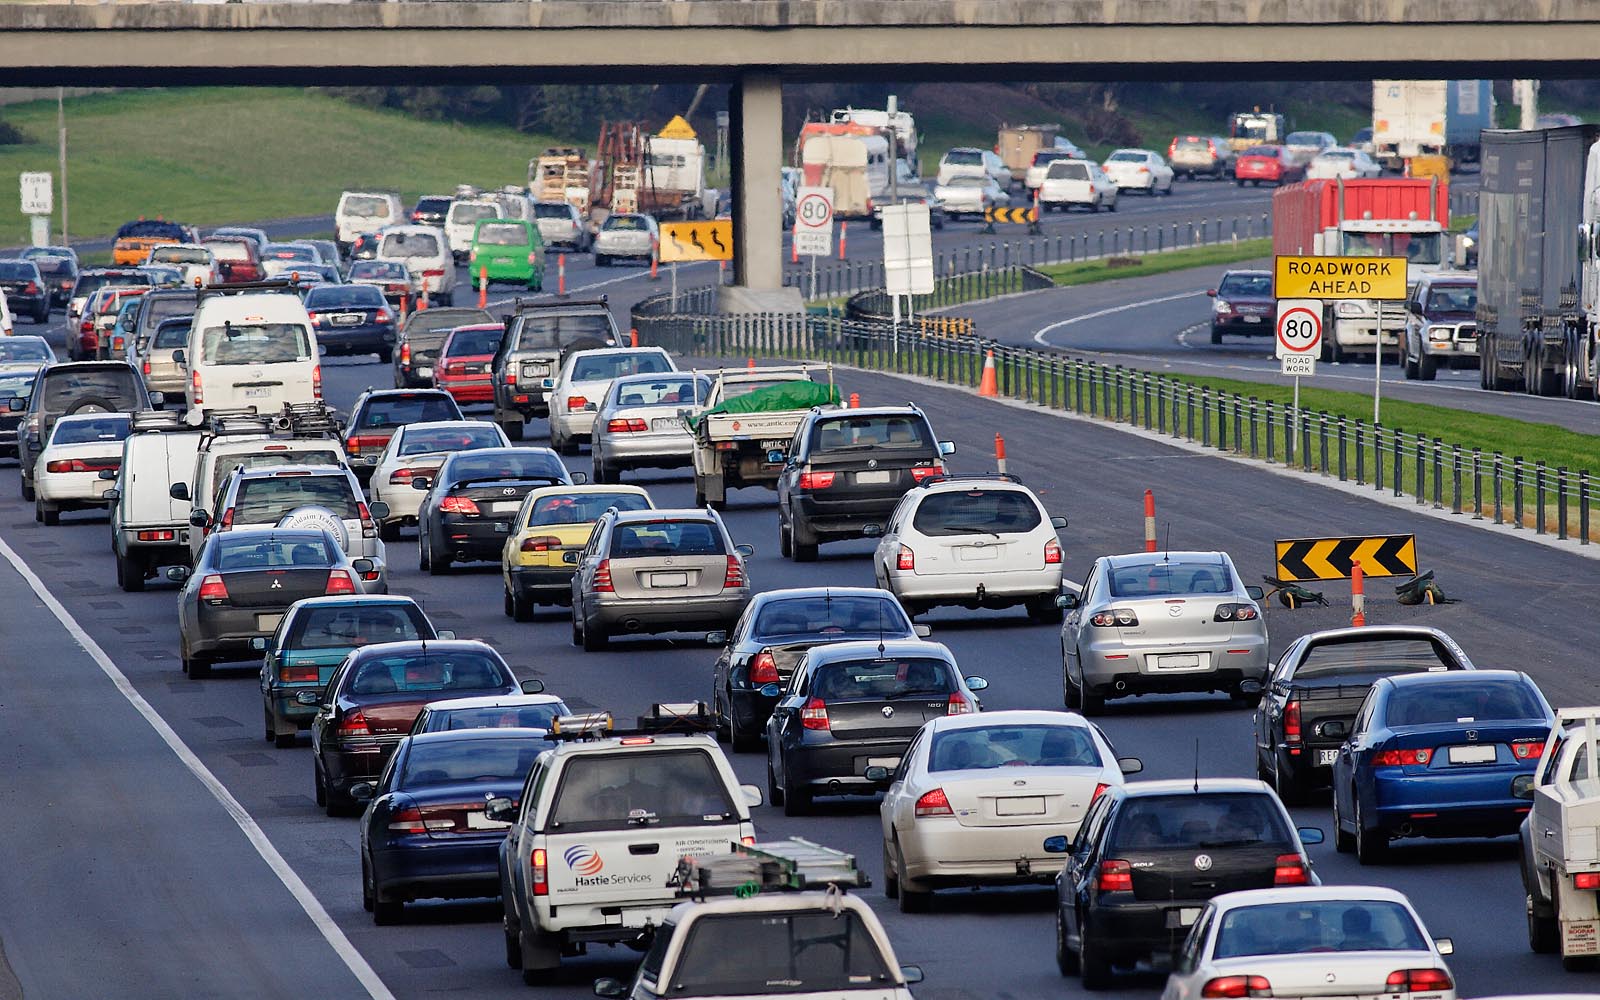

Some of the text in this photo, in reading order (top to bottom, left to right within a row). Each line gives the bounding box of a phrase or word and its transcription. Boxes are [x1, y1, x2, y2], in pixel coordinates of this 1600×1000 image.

[802, 202, 827, 219] 80
[1288, 261, 1392, 276] ROADWORK
[1308, 280, 1372, 294] AHEAD
[1285, 319, 1313, 339] 80
[1285, 365, 1311, 373] WORK
[575, 873, 652, 887] Hastie Services
